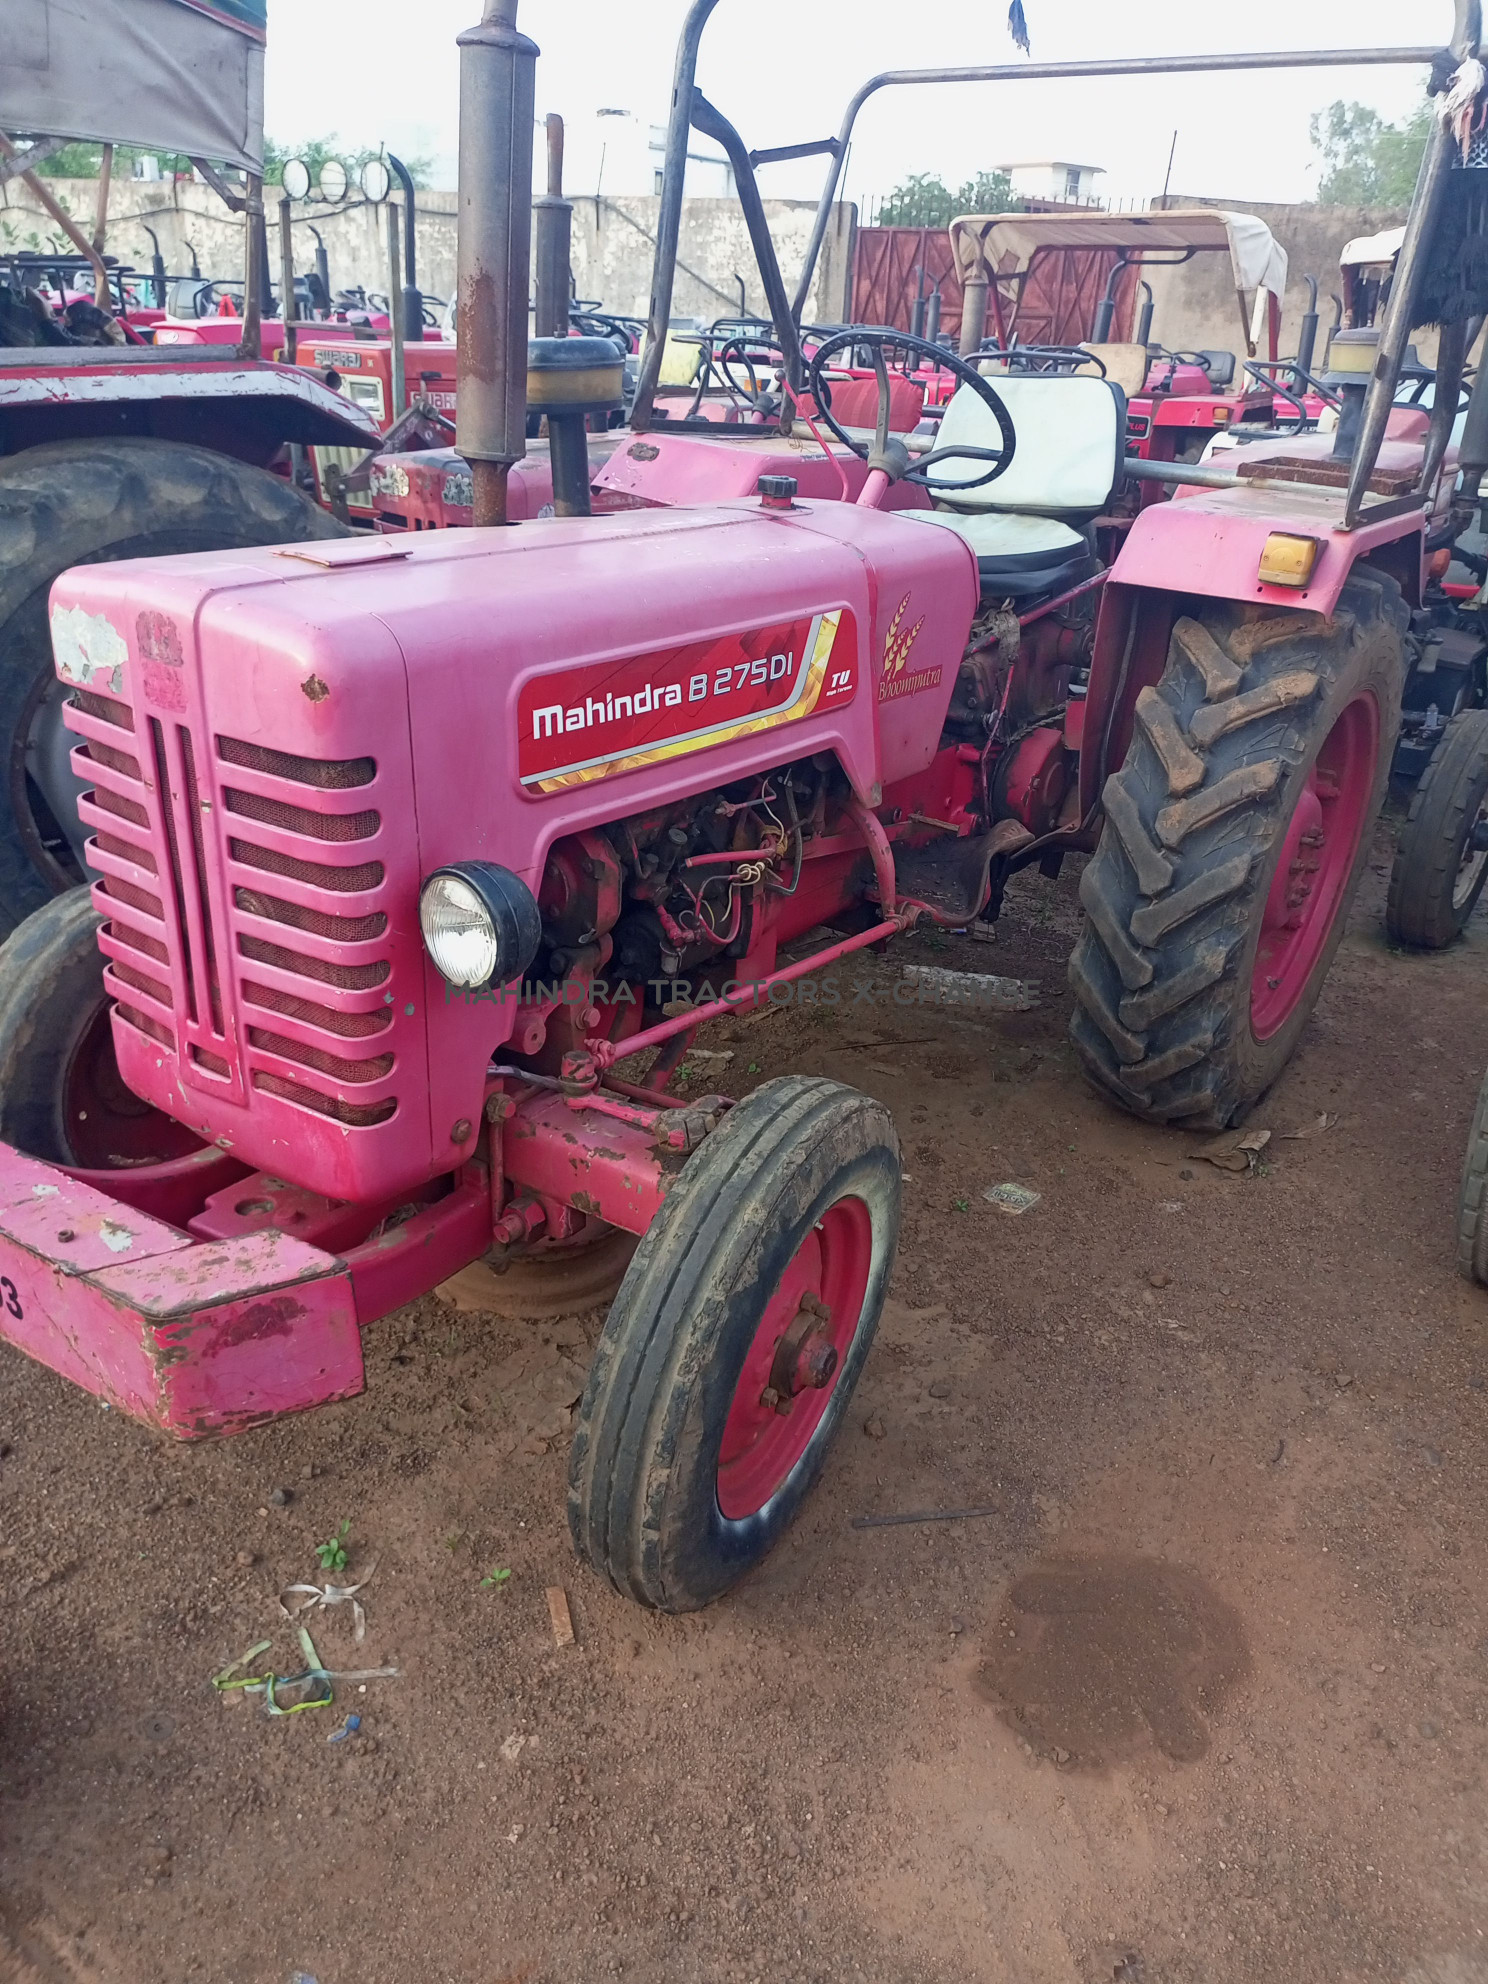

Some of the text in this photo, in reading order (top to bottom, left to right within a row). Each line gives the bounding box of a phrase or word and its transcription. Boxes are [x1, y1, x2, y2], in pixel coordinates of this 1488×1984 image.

[831, 669, 851, 688] TU
[878, 668, 941, 701] Bhoomiputra
[533, 683, 682, 740] Mahindra
[688, 673, 708, 702] B
